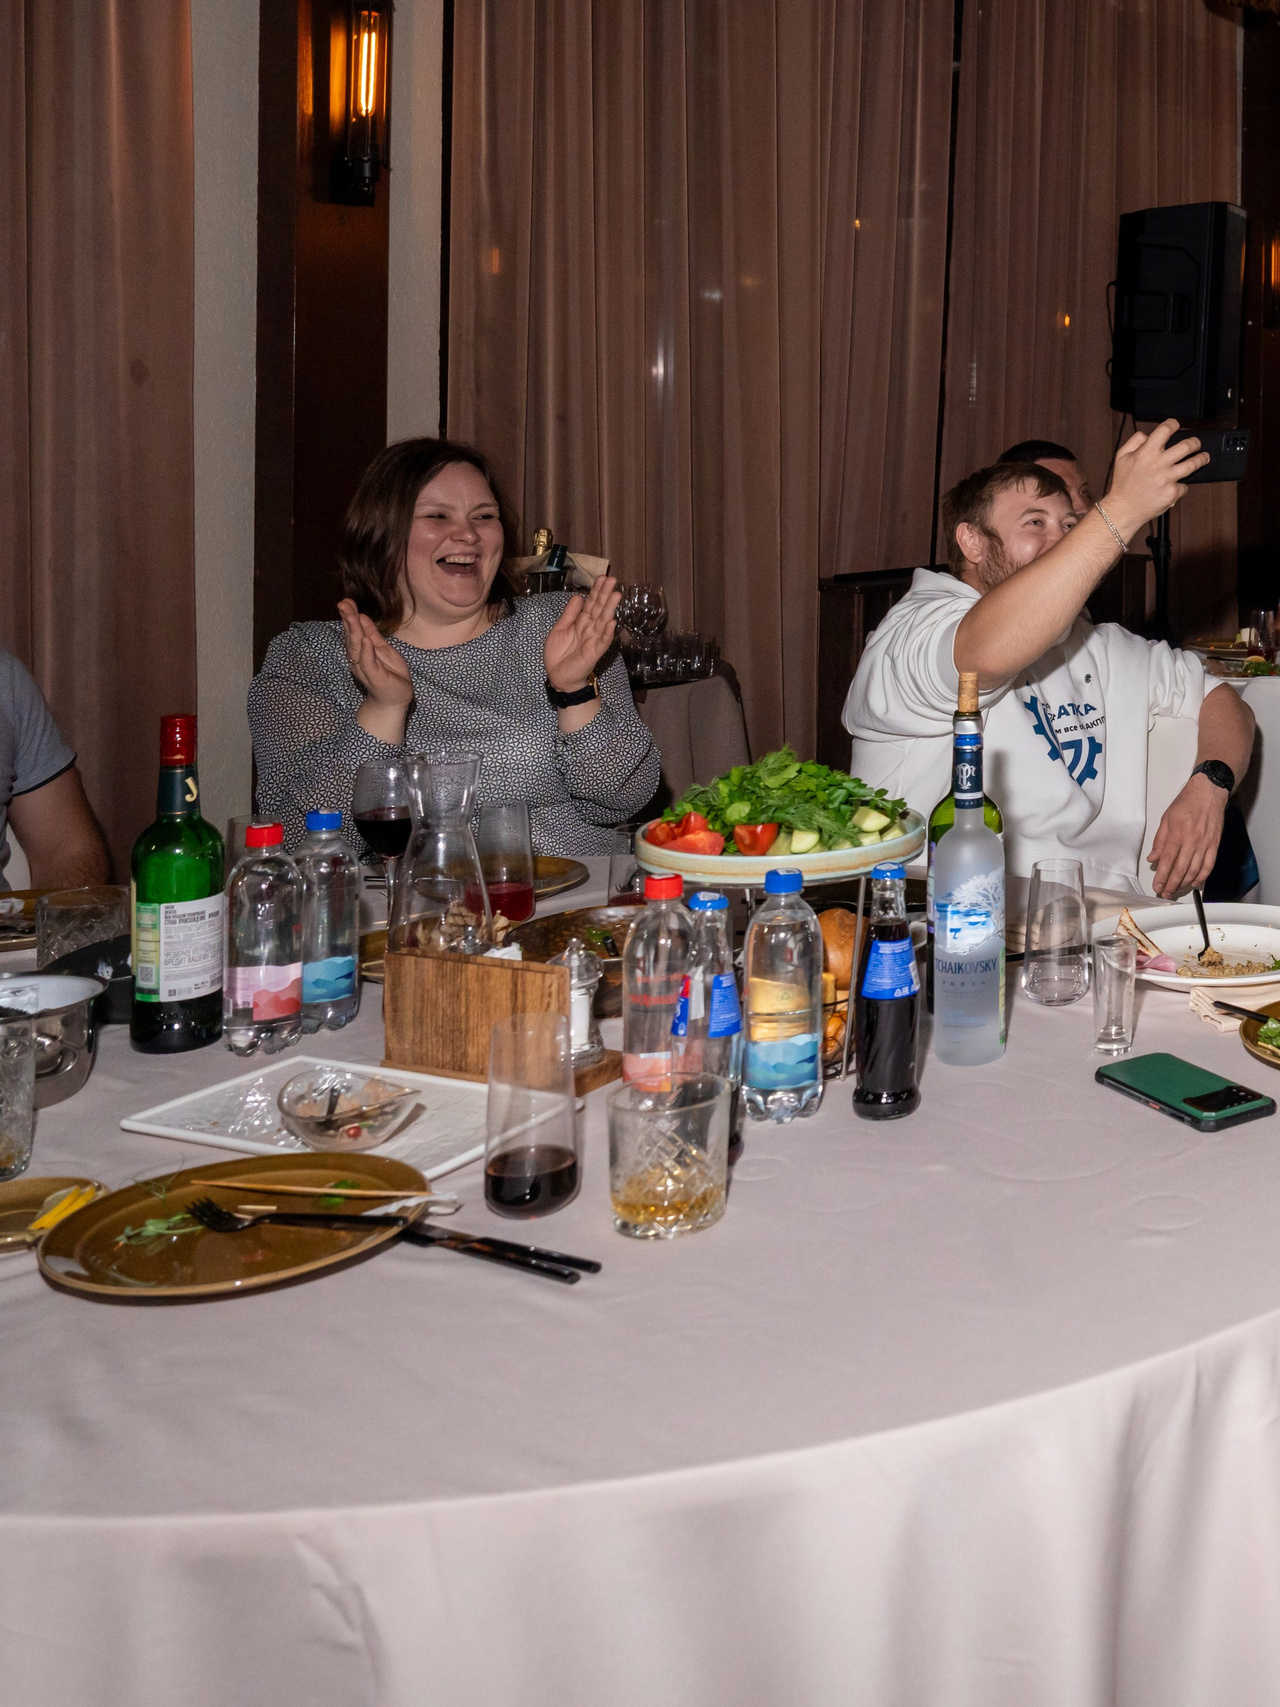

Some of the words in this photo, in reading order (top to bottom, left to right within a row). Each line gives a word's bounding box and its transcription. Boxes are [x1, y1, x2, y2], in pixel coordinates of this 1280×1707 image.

[1064, 725, 1078, 733] все
[164, 957, 186, 966] ВРЕДИТ
[187, 953, 209, 963] ВАШЕМУ
[935, 957, 997, 974] TCHAIKOVSKY
